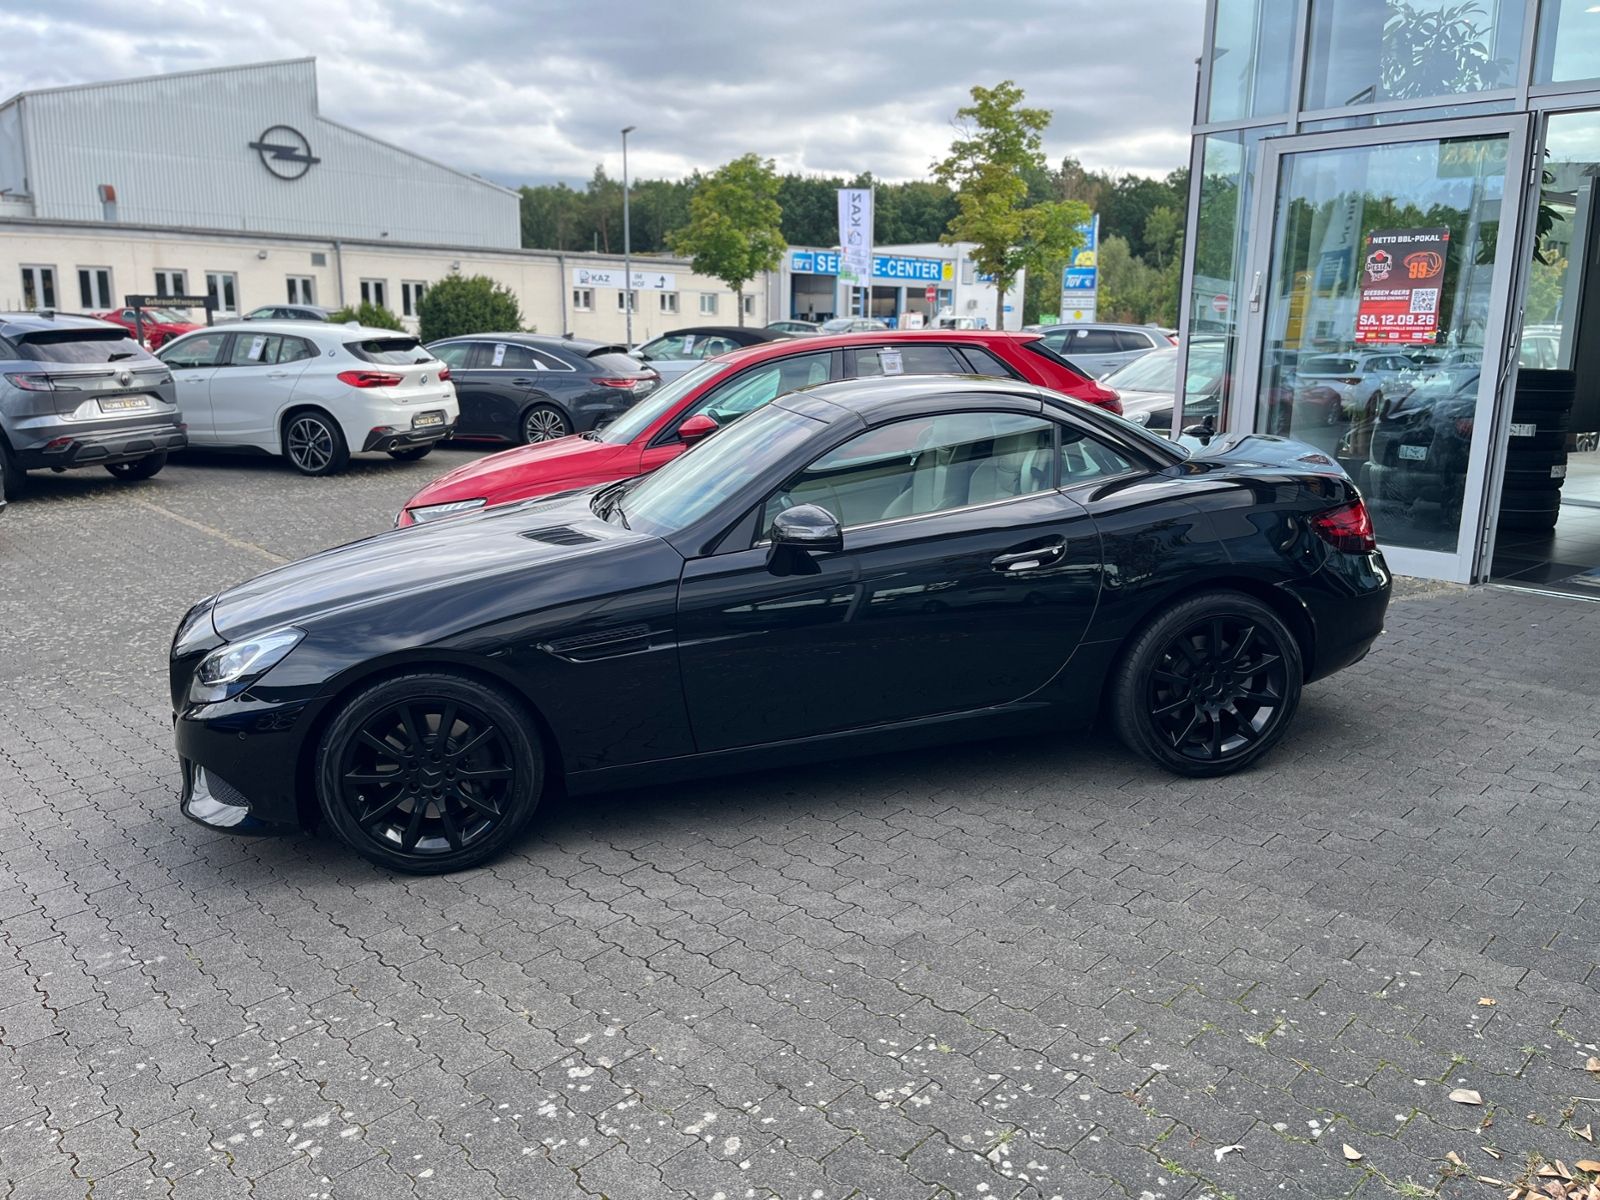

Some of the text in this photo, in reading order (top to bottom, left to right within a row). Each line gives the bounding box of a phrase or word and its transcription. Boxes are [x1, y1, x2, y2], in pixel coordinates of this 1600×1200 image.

[1372, 234, 1440, 244] NETTO BBL-POKAL
[816, 254, 940, 279] SEE-CENTER
[1408, 262, 1428, 279] 99
[591, 273, 611, 282] KAZ
[144, 297, 204, 307] Gebrauchtwagen
[1359, 314, 1435, 325] SA. 12.09.26
